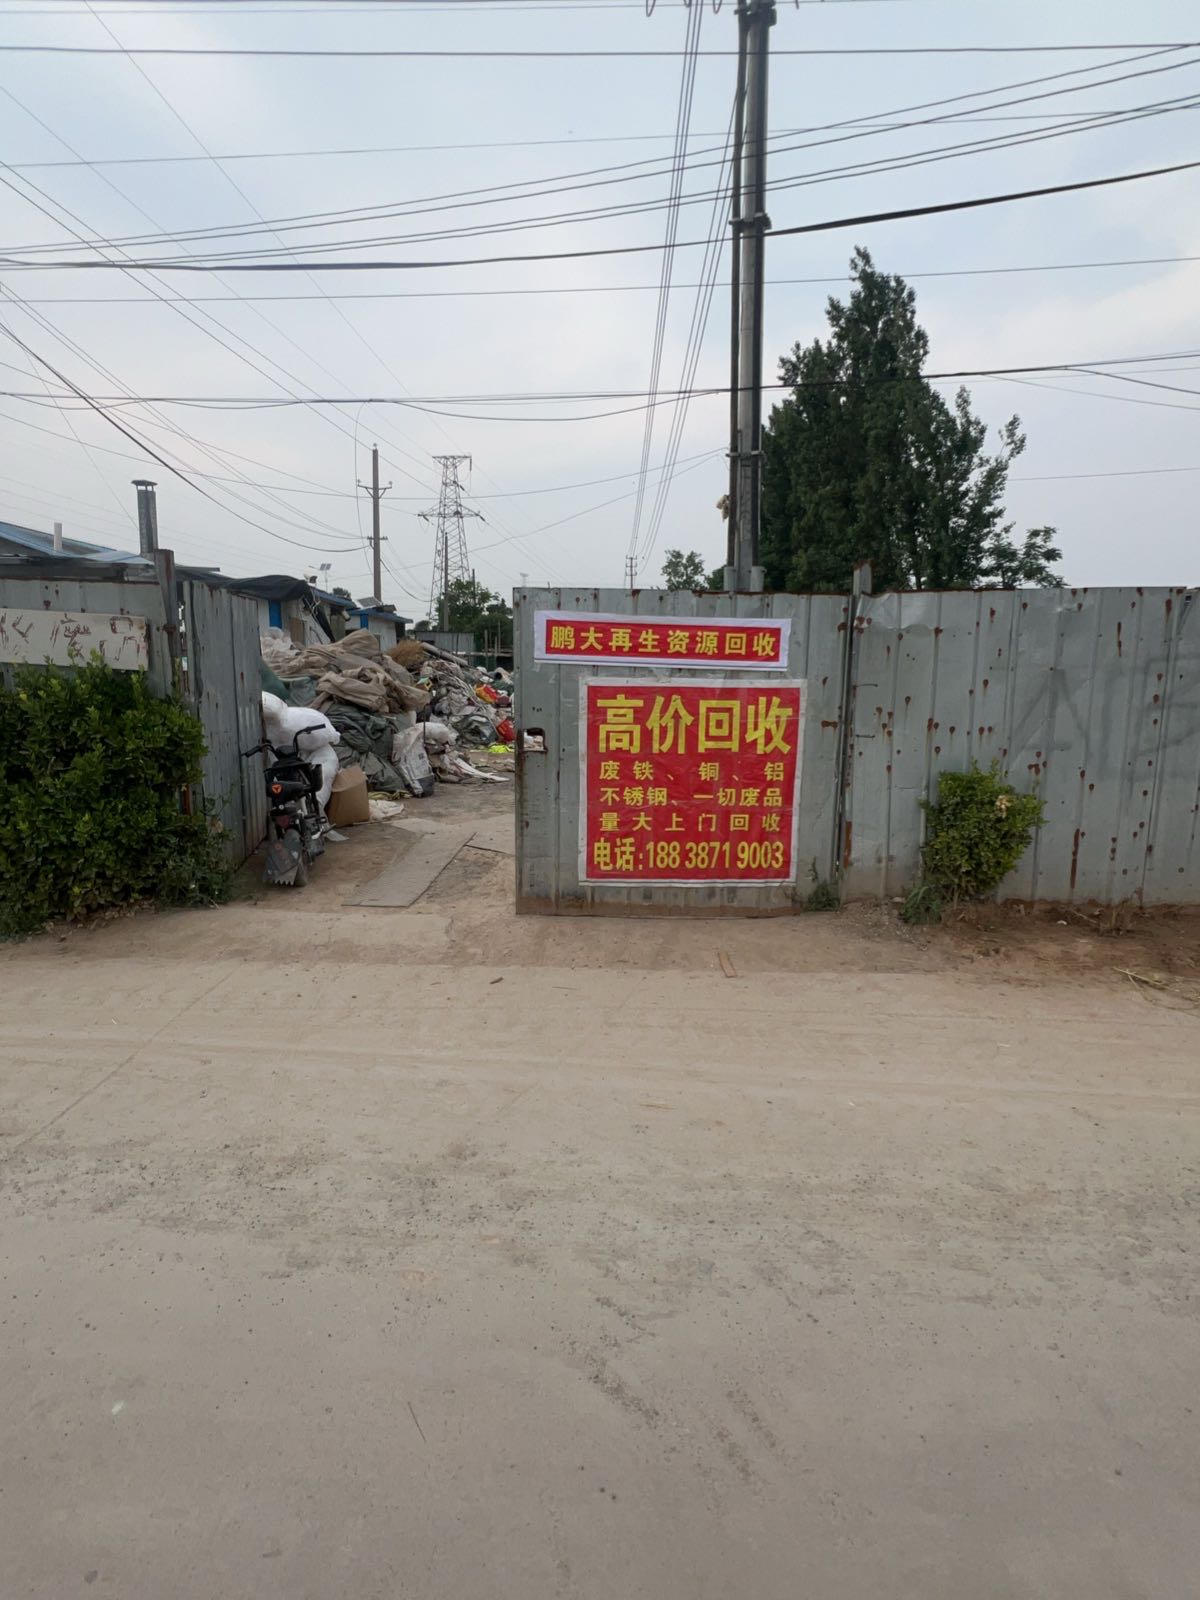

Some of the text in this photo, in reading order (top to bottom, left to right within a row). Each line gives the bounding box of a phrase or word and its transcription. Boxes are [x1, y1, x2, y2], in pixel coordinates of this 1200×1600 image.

[551, 626, 775, 656] 鹏大再生资源回收
[597, 694, 792, 755] 高价回收
[599, 812, 780, 832] 量大上门回收
